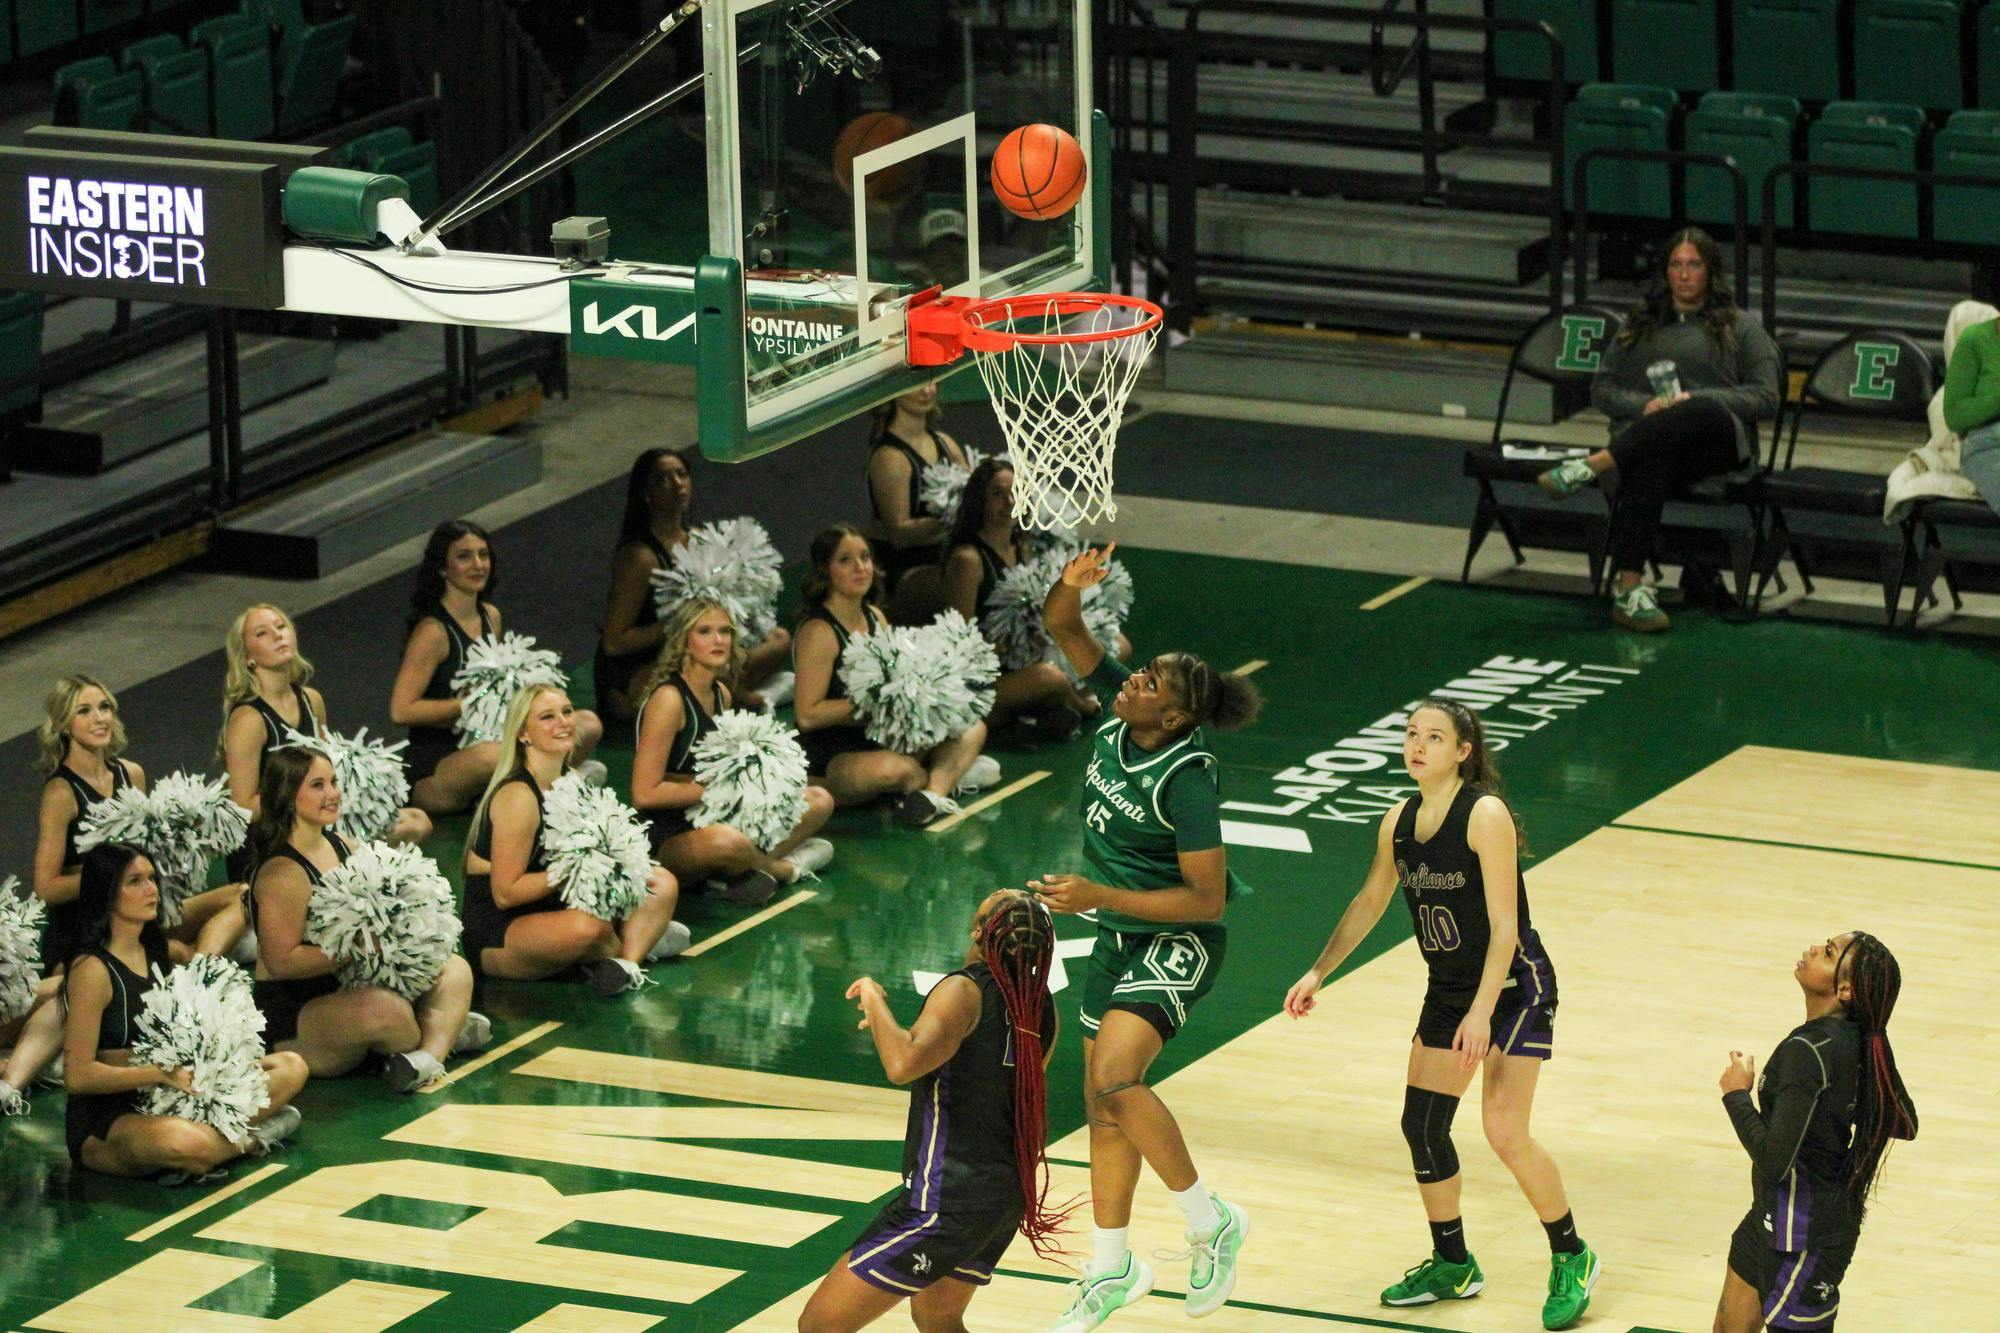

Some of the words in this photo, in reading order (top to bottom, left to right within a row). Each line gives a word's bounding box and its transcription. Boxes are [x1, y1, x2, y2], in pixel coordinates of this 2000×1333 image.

[28, 176, 205, 236] EASTERN
[30, 227, 206, 286] INSIDER
[1556, 315, 1606, 373] E
[1848, 341, 1900, 400] E
[1086, 800, 1113, 834] 15
[1397, 859, 1466, 898] Defiance
[1419, 904, 1461, 952] 10
[1163, 941, 1195, 978] E
